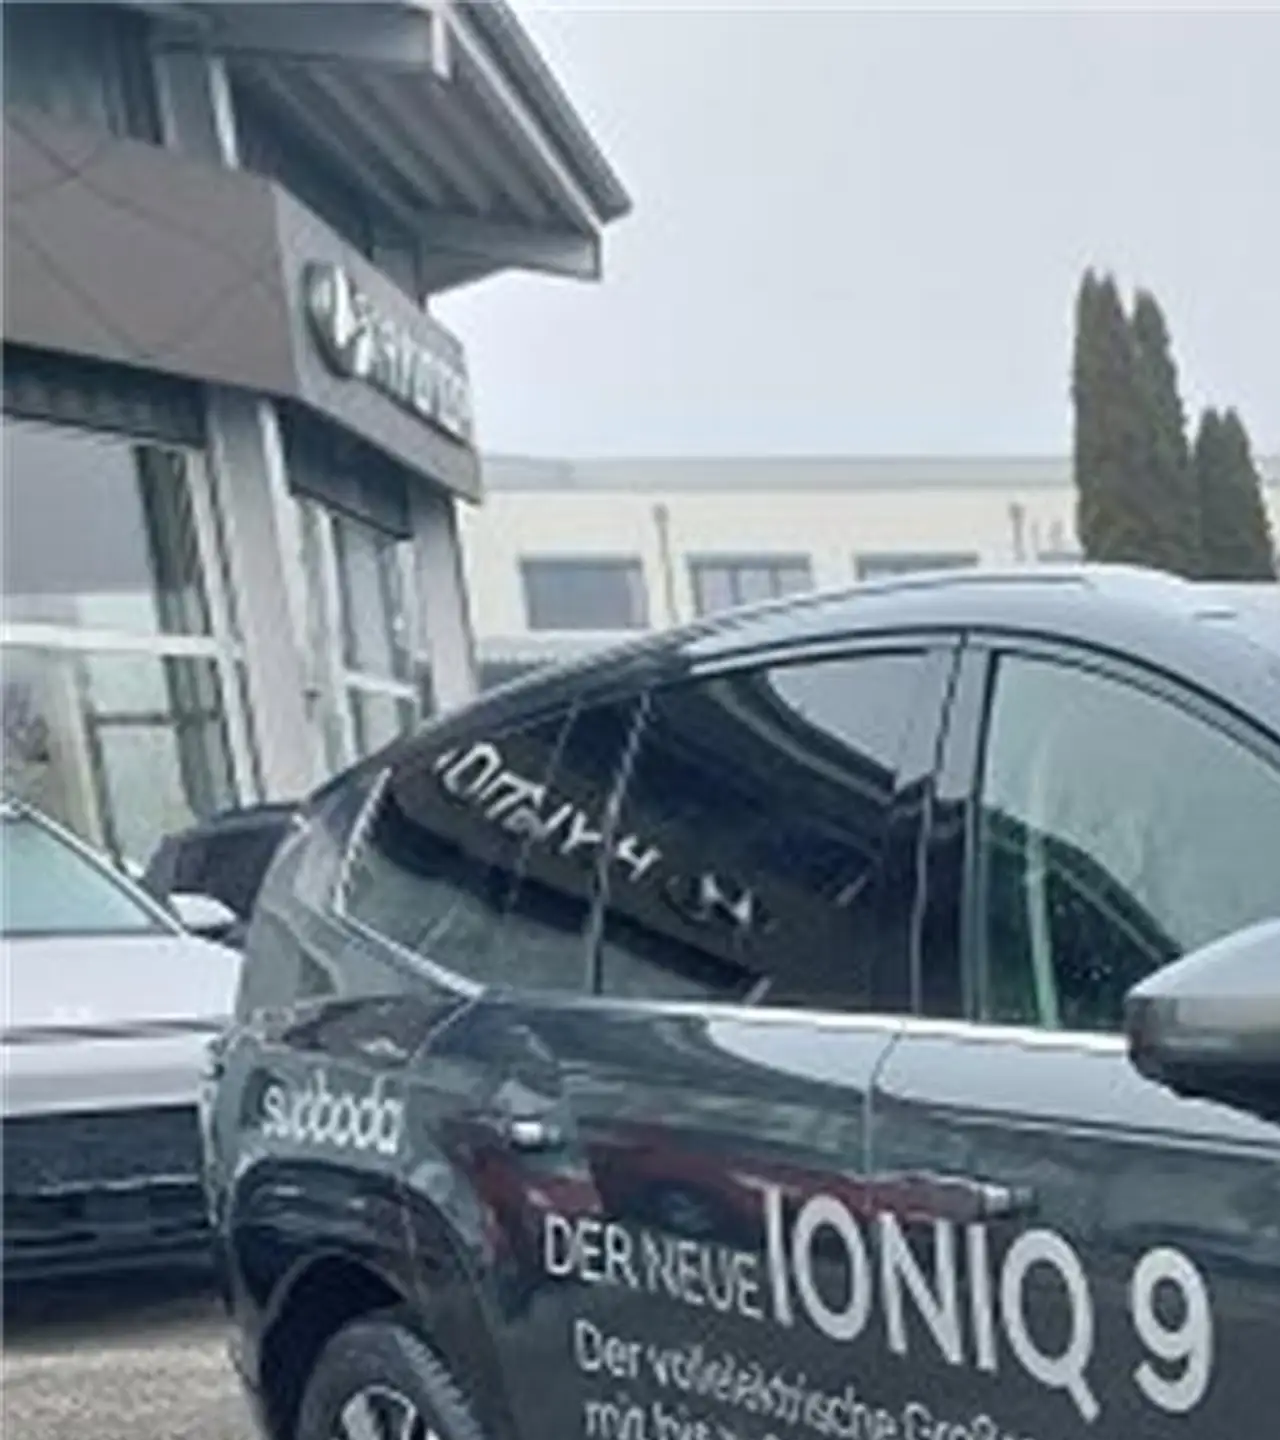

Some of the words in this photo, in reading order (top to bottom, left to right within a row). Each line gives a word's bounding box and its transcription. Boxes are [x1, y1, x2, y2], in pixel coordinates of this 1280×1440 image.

[262, 1068, 404, 1156] svoboda
[544, 1213, 638, 1290] DER
[640, 1231, 764, 1321] NEUE
[763, 1187, 1100, 1424] IONIQ
[1131, 1246, 1214, 1413] 9
[574, 1318, 642, 1378] Der
